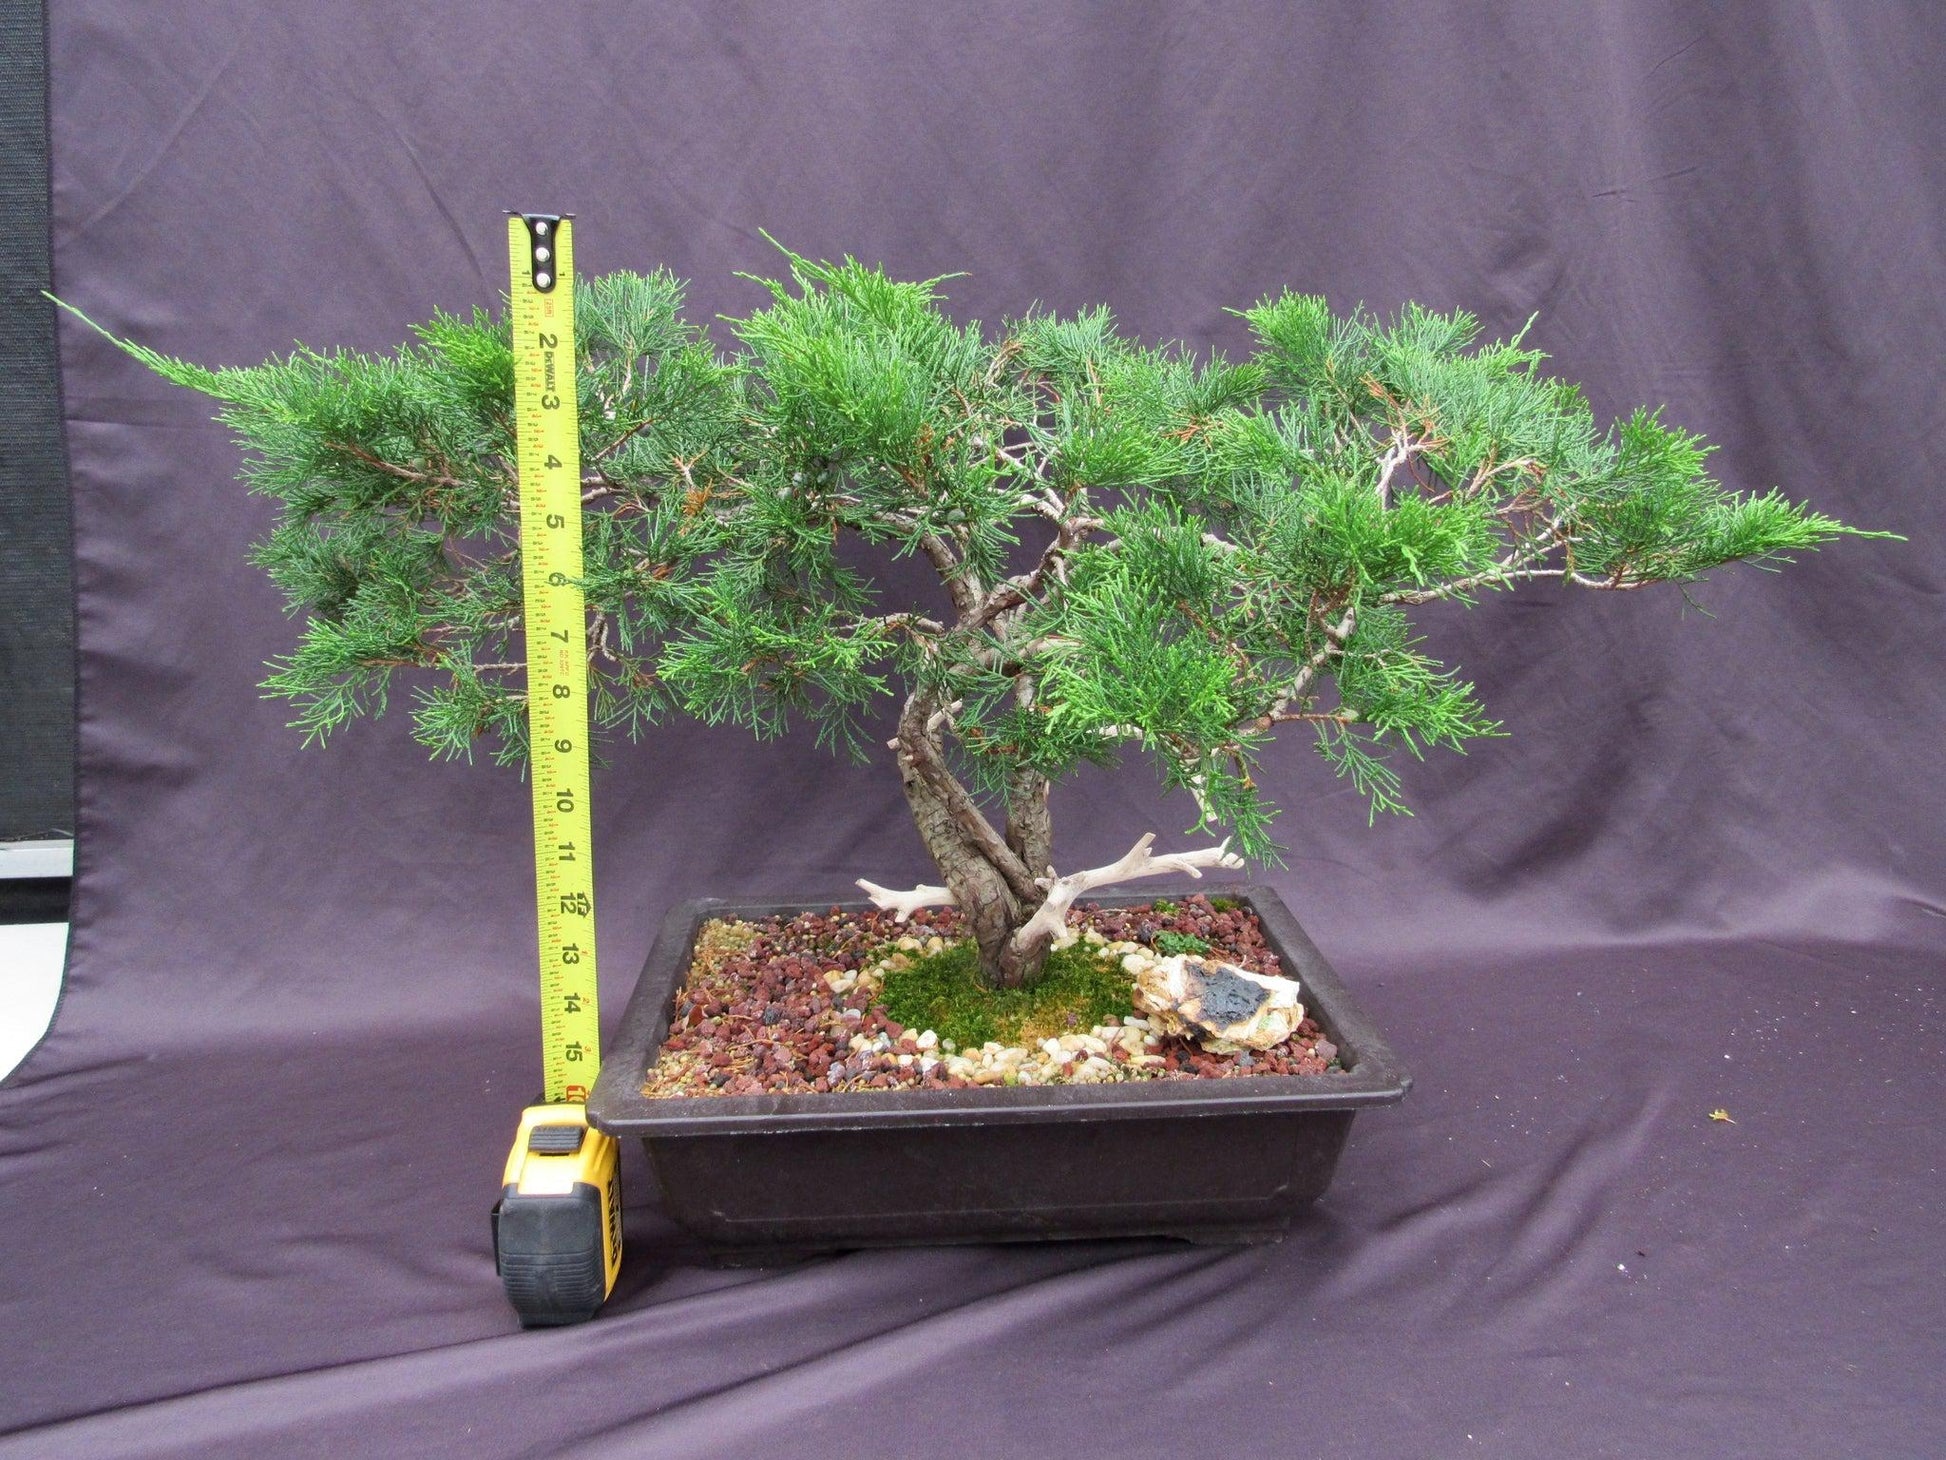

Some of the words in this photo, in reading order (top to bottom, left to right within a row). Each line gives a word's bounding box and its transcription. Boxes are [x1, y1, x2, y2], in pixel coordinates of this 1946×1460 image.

[539, 333, 558, 348] 2
[542, 395, 560, 410] 3
[544, 454, 562, 470] 4
[546, 514, 565, 529] 5
[549, 572, 567, 587] 6
[551, 630, 568, 643] 7
[552, 684, 570, 699] 8
[555, 739, 572, 753] 9
[557, 788, 574, 813] 10
[558, 842, 575, 861] 11
[560, 892, 577, 914] 12
[562, 943, 580, 965] 13
[564, 993, 581, 1013] 14
[566, 1041, 583, 1062] 15
